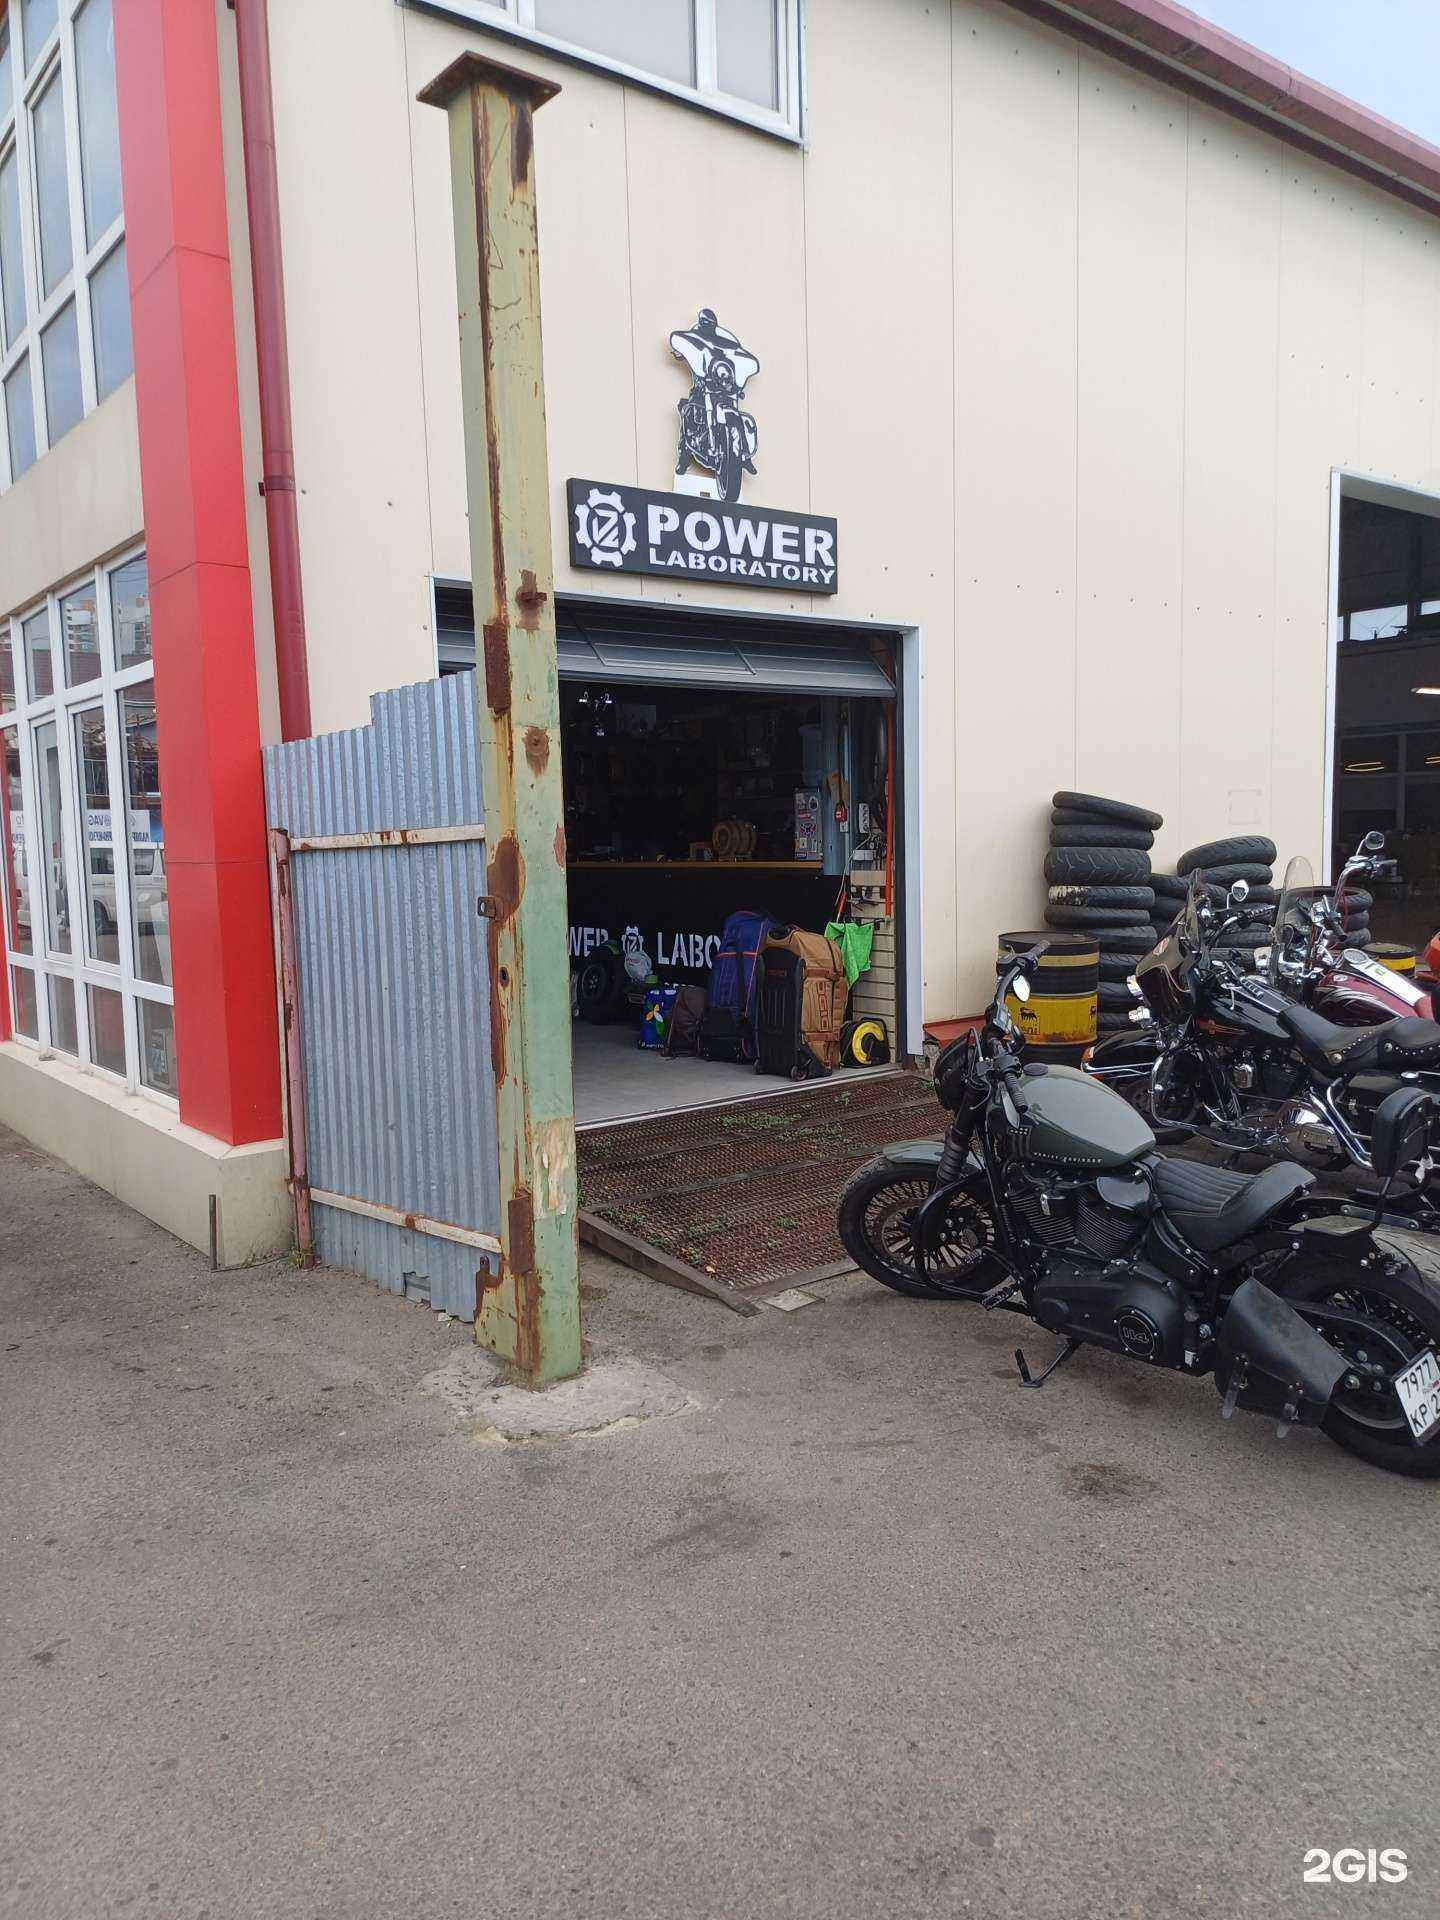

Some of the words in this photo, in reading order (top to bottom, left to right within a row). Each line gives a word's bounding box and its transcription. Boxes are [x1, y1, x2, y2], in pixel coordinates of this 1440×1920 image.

[647, 504, 836, 567] POWER
[649, 547, 836, 585] LABORATORY
[1401, 1357, 1432, 1399] 7977
